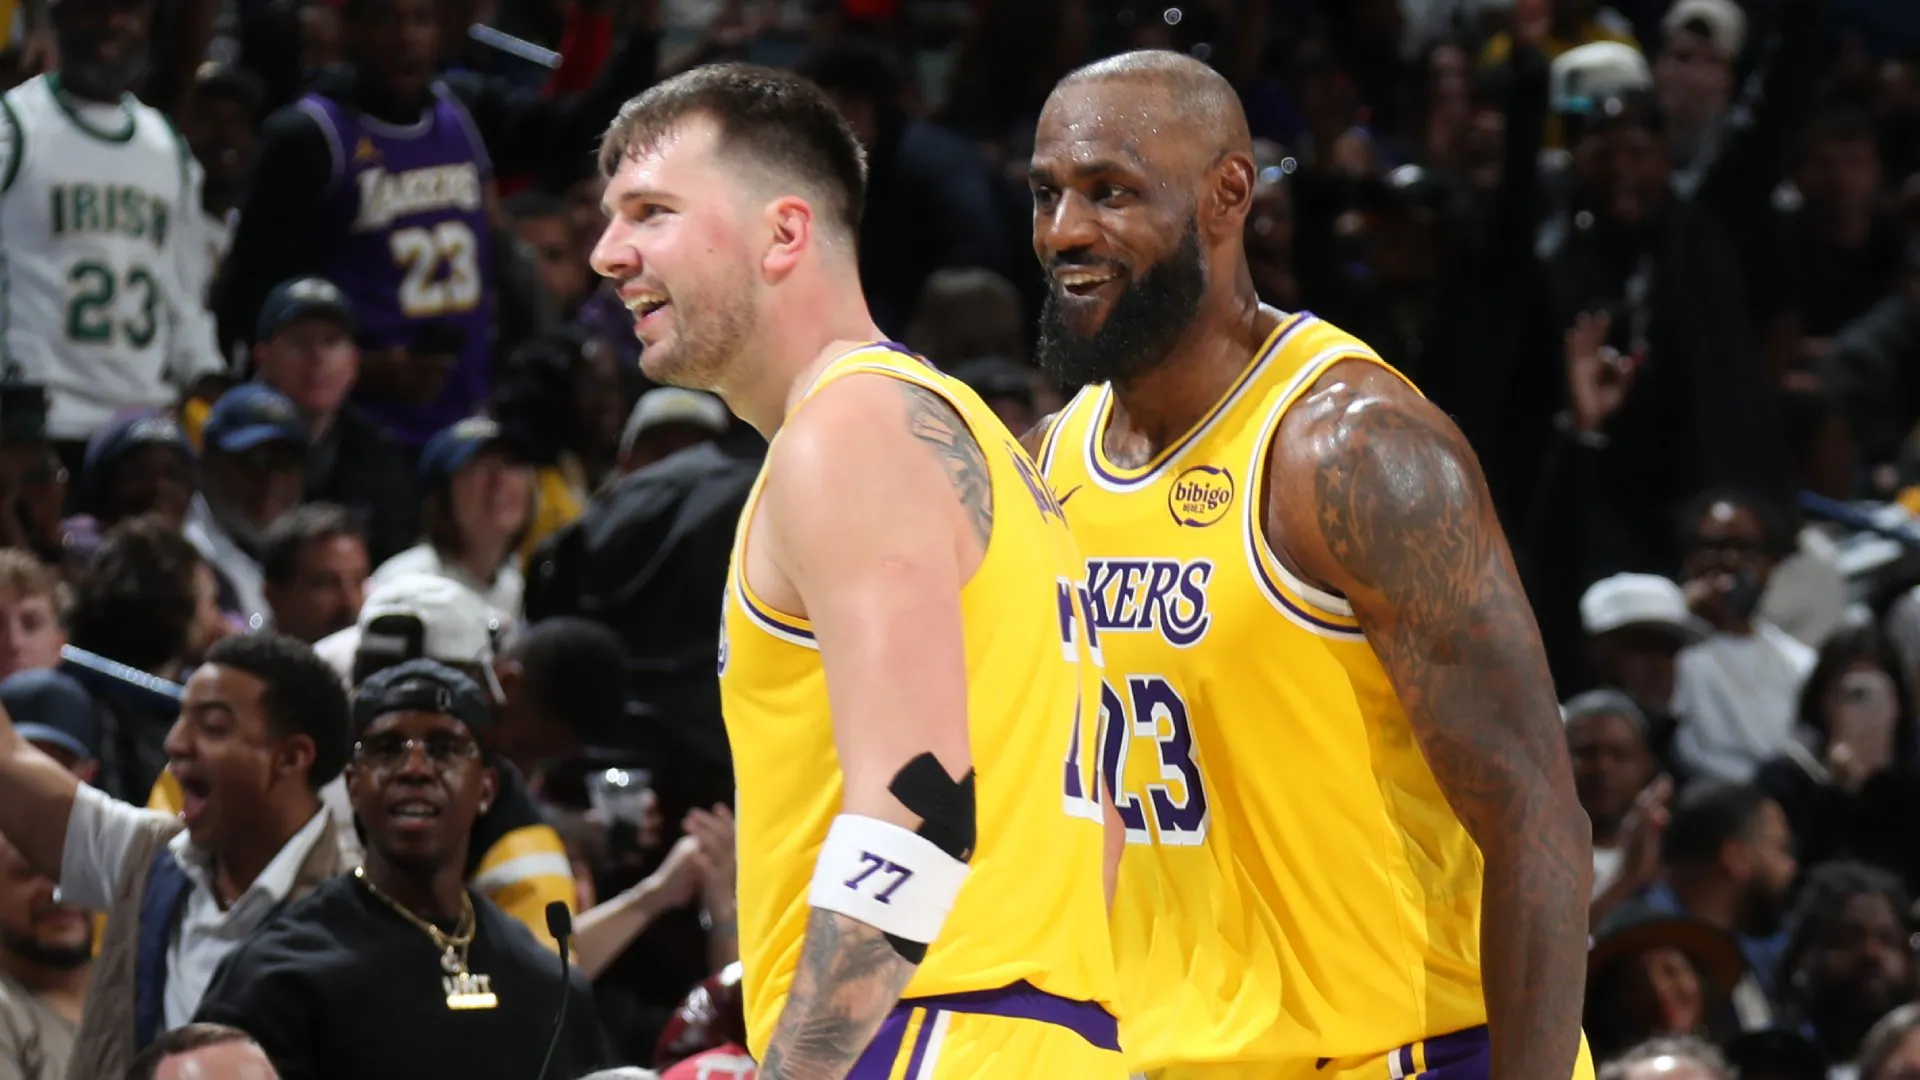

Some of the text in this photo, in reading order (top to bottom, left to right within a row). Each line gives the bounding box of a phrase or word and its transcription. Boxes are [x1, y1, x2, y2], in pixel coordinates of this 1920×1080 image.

[67, 260, 159, 348] 23
[389, 221, 482, 316] 23
[1174, 481, 1230, 510] bibigo
[843, 850, 914, 905] 77
